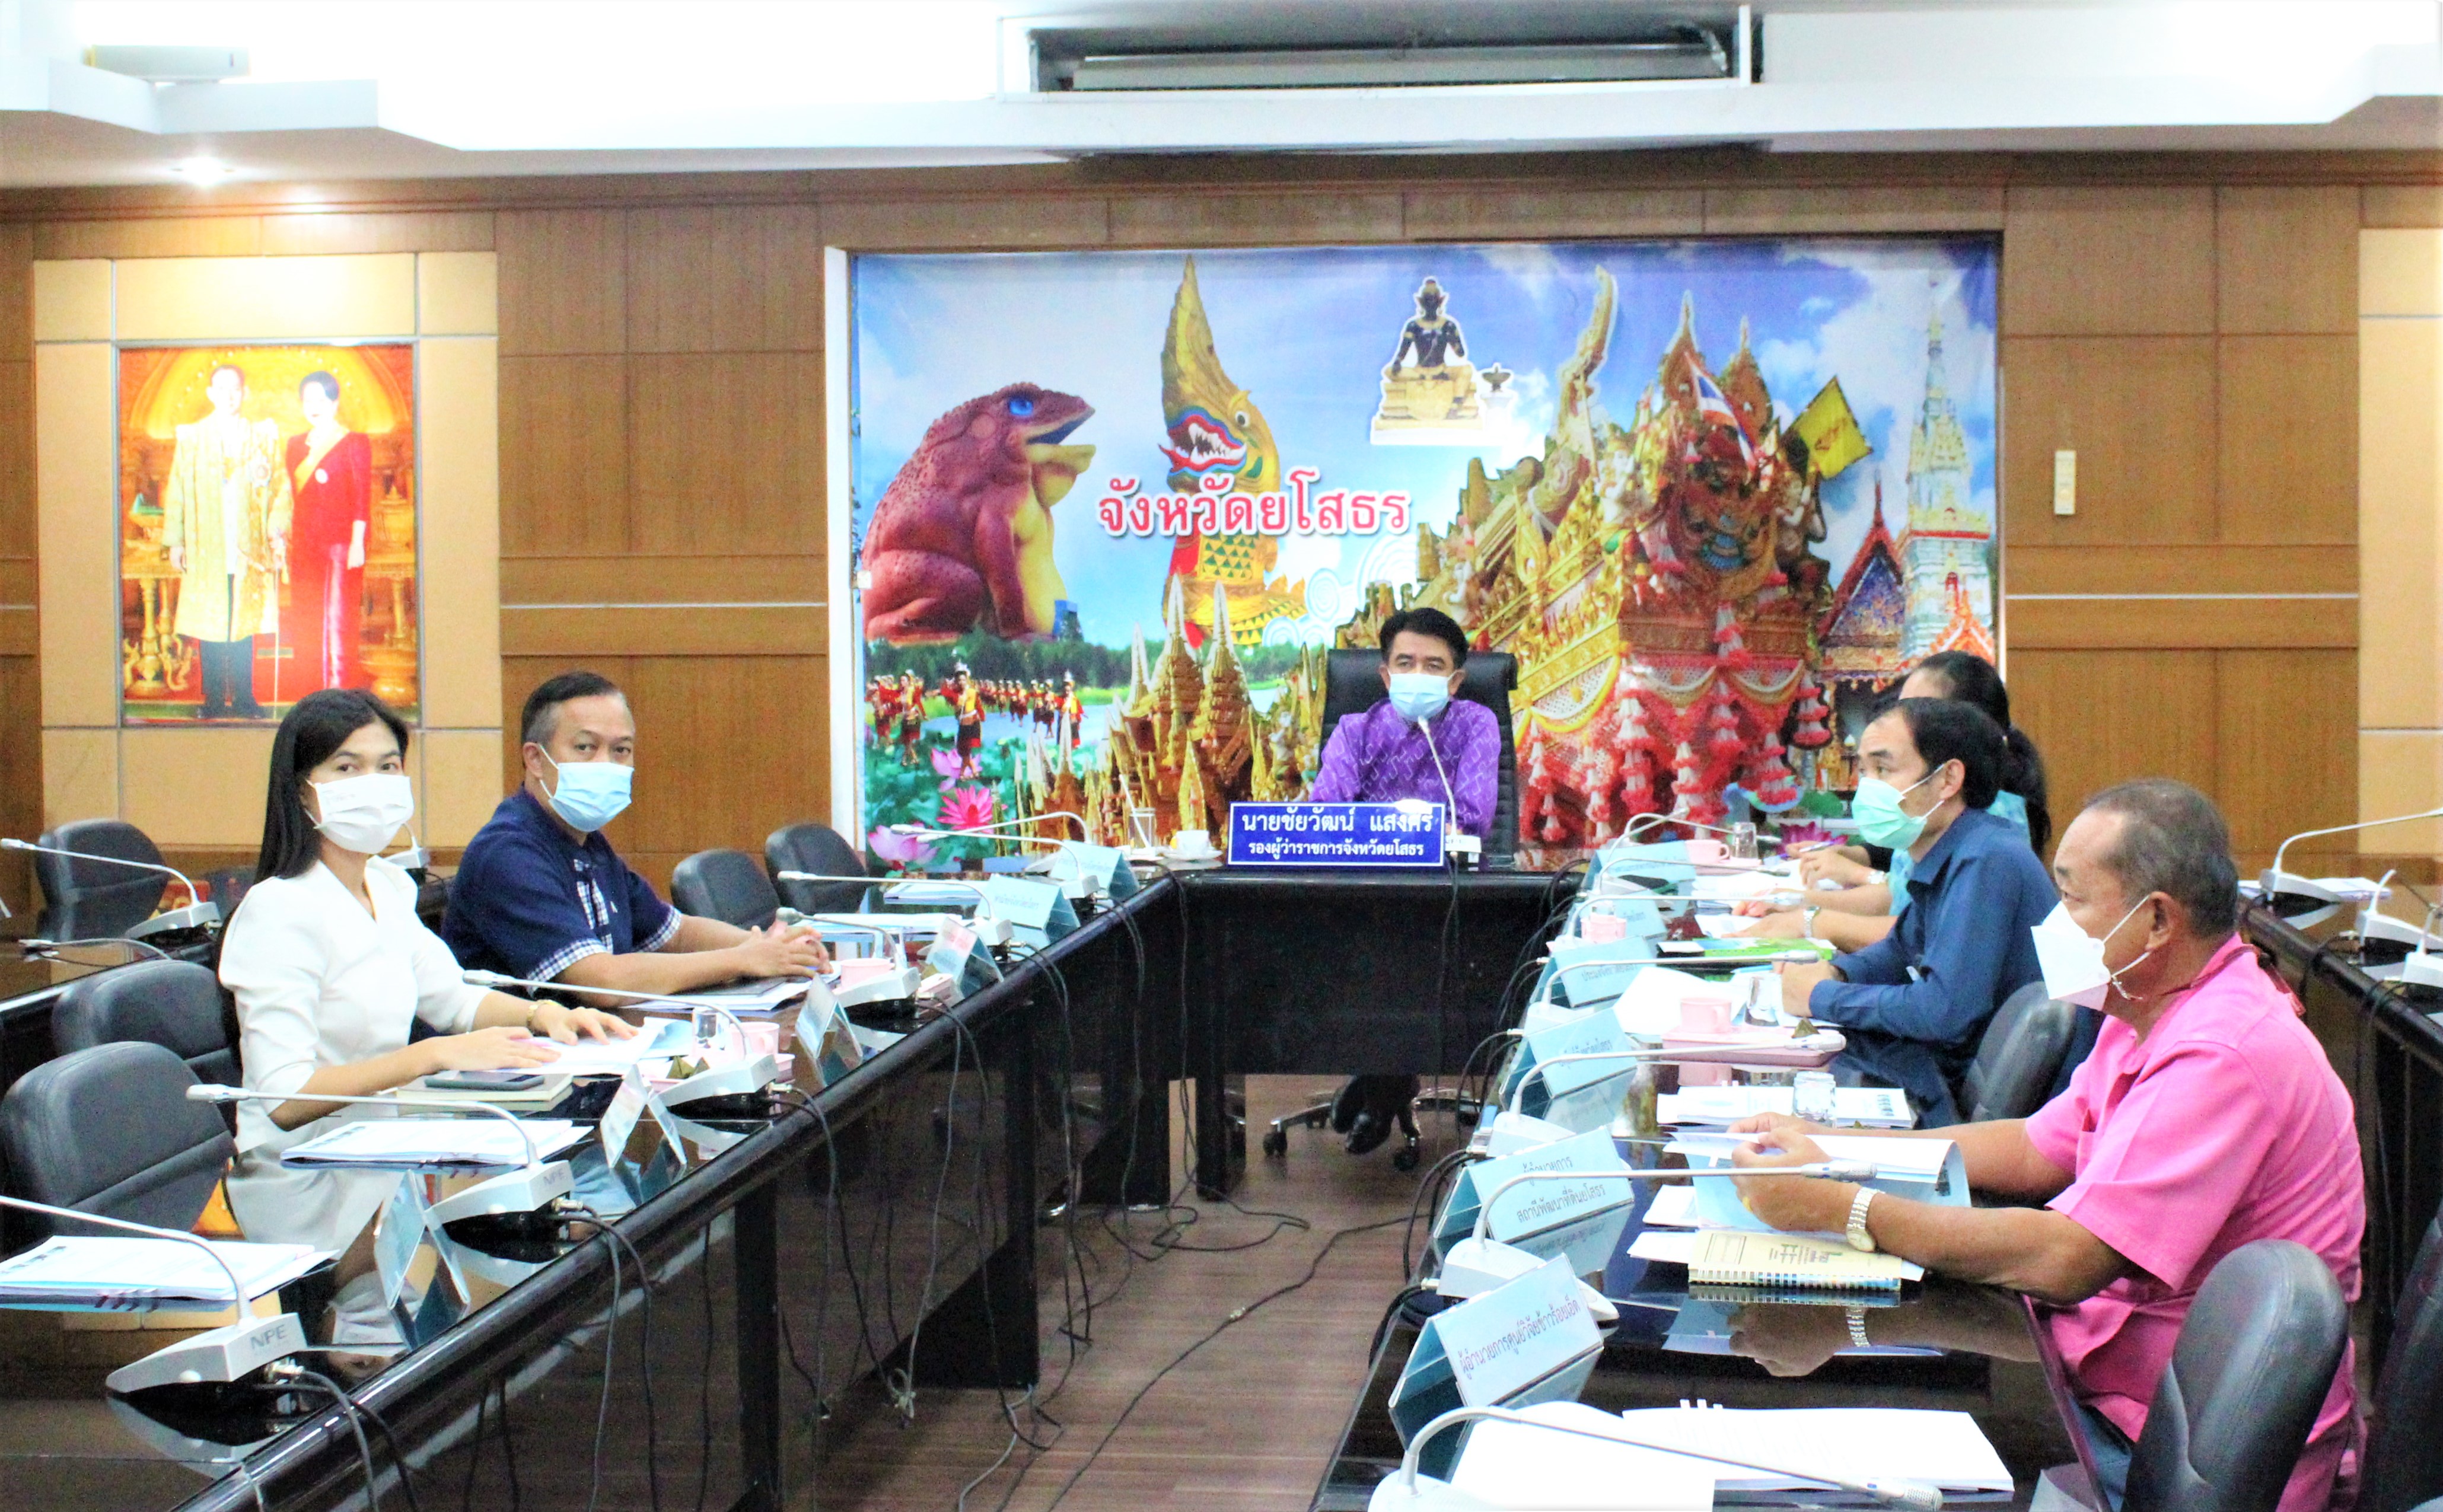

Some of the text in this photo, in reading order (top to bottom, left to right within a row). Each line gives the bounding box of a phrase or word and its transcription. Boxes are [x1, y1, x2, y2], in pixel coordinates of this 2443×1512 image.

[1097, 468, 1408, 533] จังหวัดยโสธร
[1242, 806, 1434, 832] นายชัยวัฒน์ แสงศร
[1248, 836, 1424, 860] รองผู้ว่าราชการจังหวัดยโสธร
[250, 1323, 288, 1350] NPE
